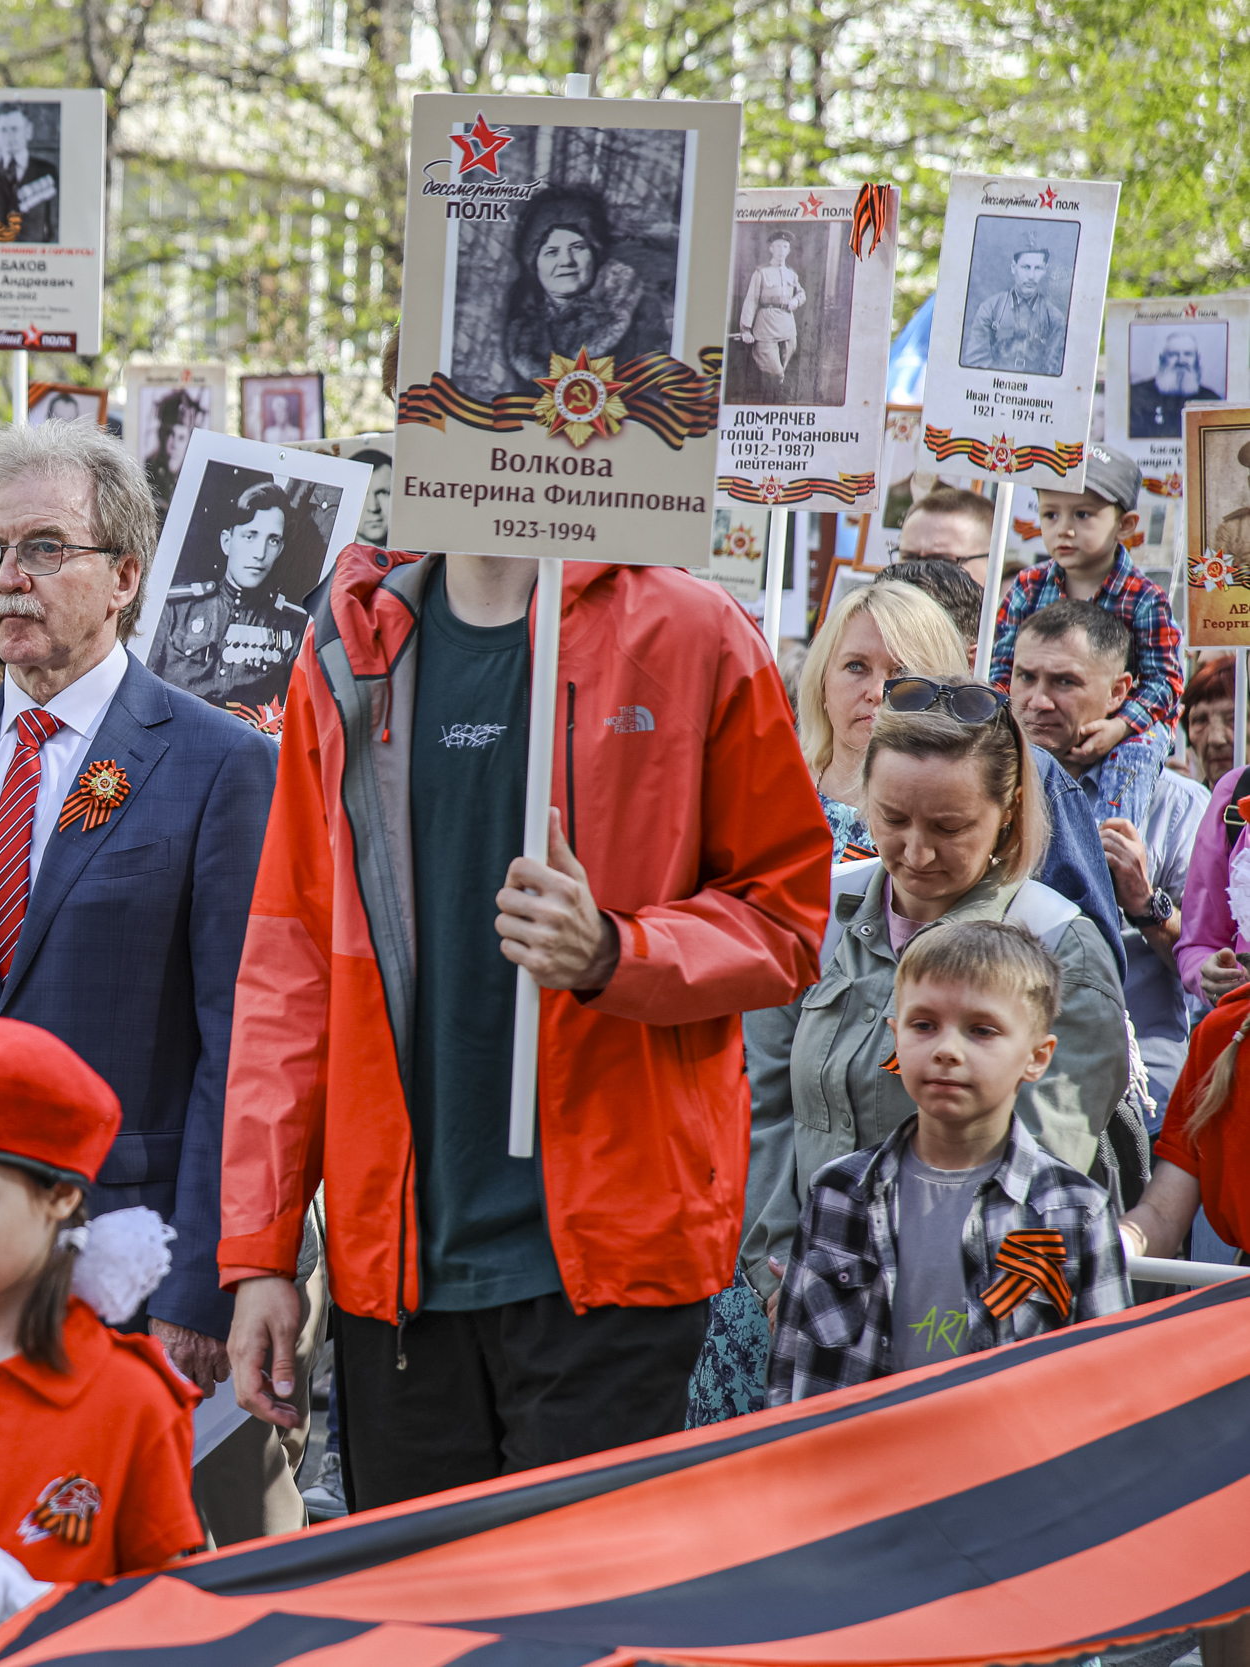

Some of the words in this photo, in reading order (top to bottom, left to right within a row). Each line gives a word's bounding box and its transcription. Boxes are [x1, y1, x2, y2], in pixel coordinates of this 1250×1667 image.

[965, 389, 990, 402] Иван
[993, 392, 1054, 409] Степанович
[733, 410, 816, 427] ДОМРАЧЕВ
[973, 404, 995, 417] 1921
[1012, 409, 1035, 422] 1974
[720, 425, 764, 441] толий
[771, 427, 859, 442] Романович
[731, 442, 814, 457] (1912-1987)
[490, 448, 613, 478] Волкова
[735, 456, 808, 471] лейтенант
[403, 476, 535, 507] Екатерина
[544, 483, 706, 513] Филипповна
[493, 519, 596, 541] 1923-1994
[1229, 603, 1250, 615] ЛЕ
[618, 705, 635, 715] THE
[603, 715, 635, 726] NORTH
[614, 724, 635, 734] FACE
